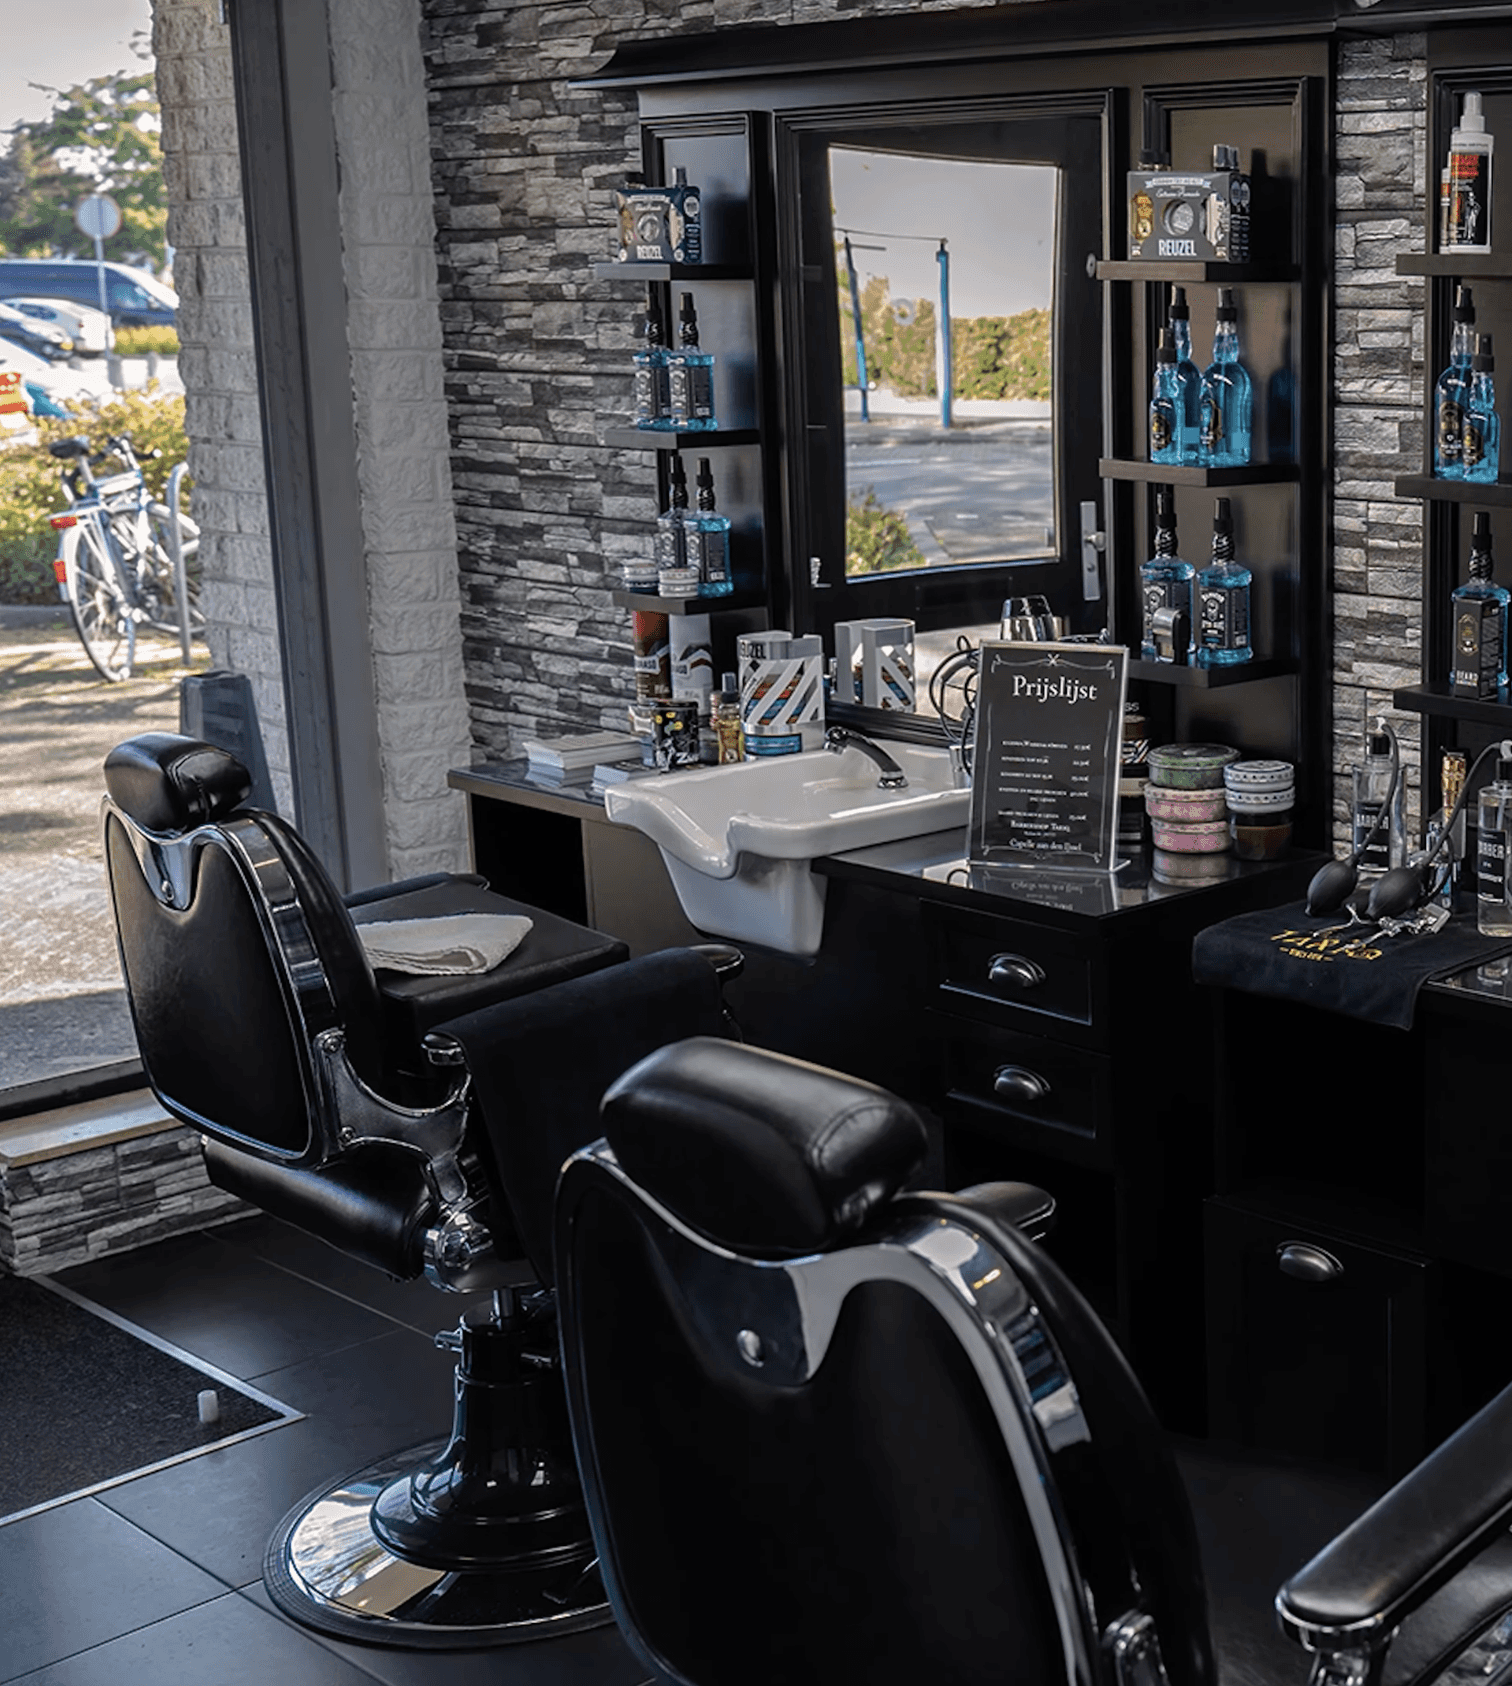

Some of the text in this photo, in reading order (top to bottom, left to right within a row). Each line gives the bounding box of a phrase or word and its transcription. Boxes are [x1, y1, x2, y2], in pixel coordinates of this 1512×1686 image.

[637, 245, 663, 260] REUZEL
[1158, 239, 1197, 256] REUZEL
[1012, 675, 1098, 704] Prijslijst
